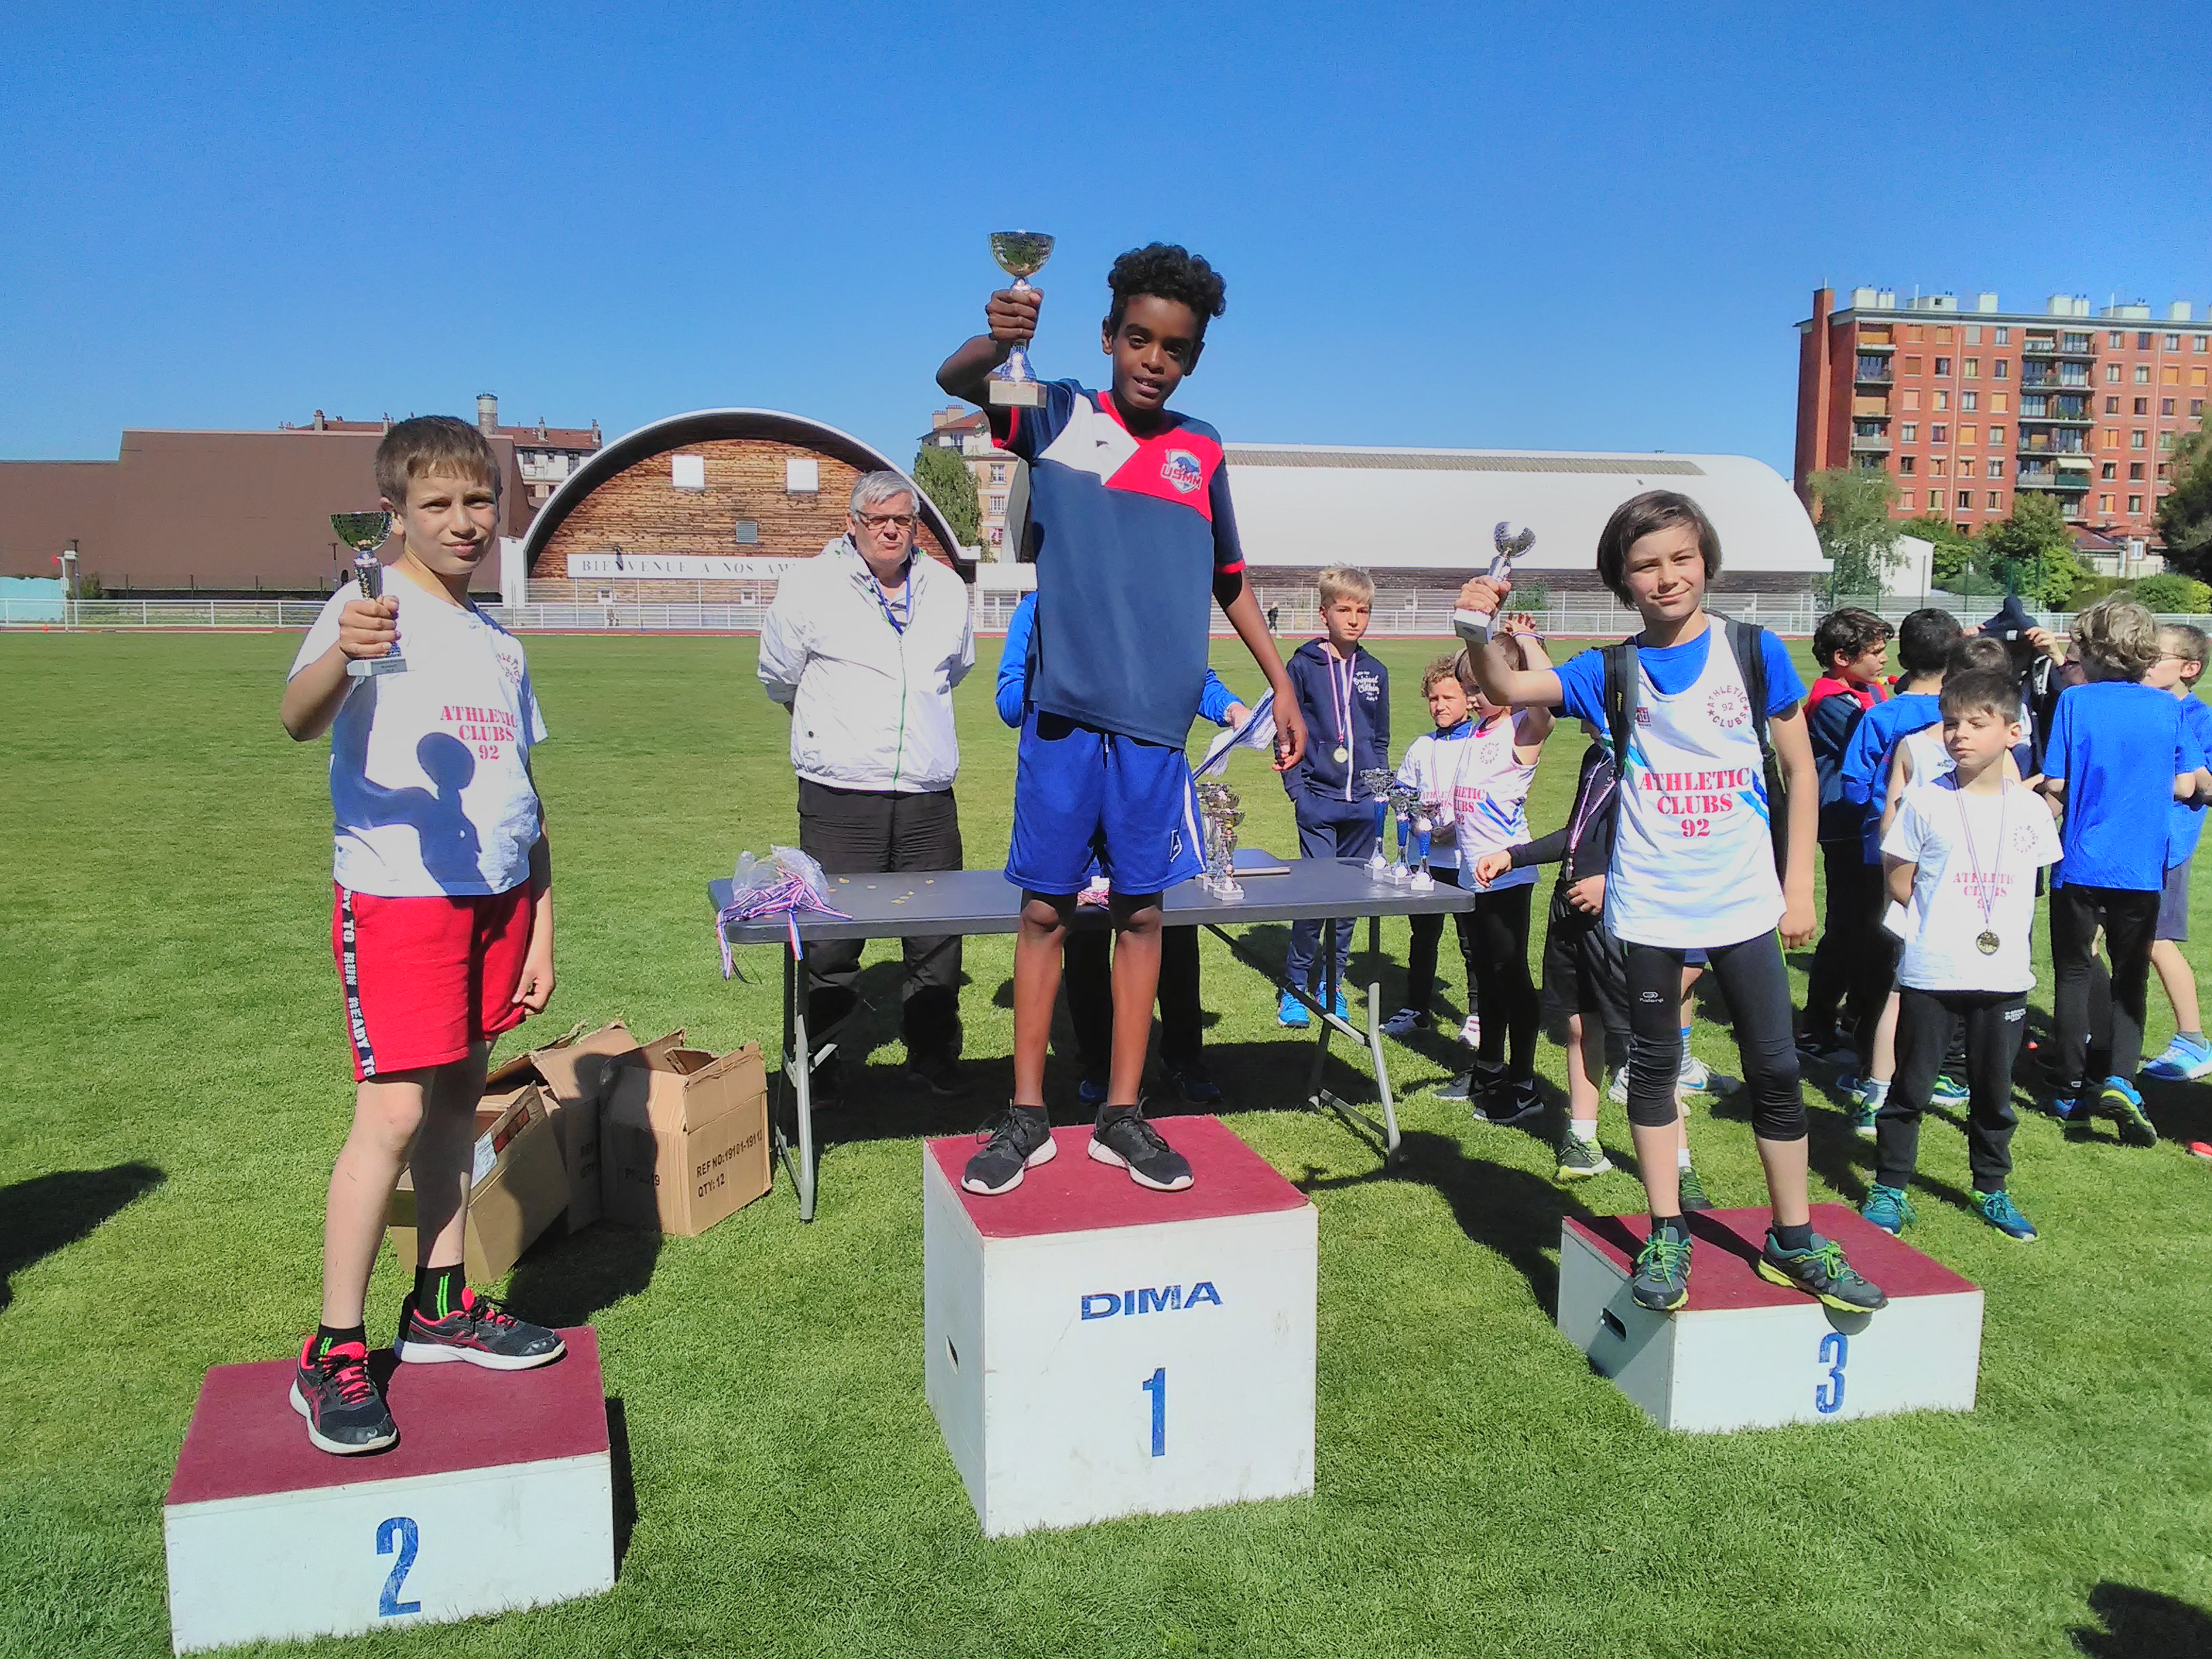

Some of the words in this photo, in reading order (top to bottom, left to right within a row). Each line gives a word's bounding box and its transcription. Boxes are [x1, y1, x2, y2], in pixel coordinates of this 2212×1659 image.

[1161, 464, 1202, 489] USMM
[582, 560, 687, 573] BIENVENUE
[701, 562, 710, 573] A
[722, 562, 754, 573] NOS
[766, 562, 797, 574] AM
[1706, 684, 1747, 708] ATHLETIC
[1721, 702, 1734, 712] 92
[441, 705, 518, 729] ATHLETIC
[1712, 712, 1746, 728] CLUBS
[458, 724, 515, 742] CLUBS
[478, 744, 499, 760] 92
[1638, 767, 1750, 792] ATHLETIC
[1454, 798, 1475, 813] LUBS
[1656, 793, 1734, 815] CLUBS
[1681, 818, 1711, 838] 92
[343, 920, 355, 943] TO
[348, 996, 371, 1049] READY
[696, 1160, 712, 1179] REF
[697, 1179, 716, 1198] QTY:
[716, 1172, 726, 1188] 12
[1080, 1280, 1224, 1321] DIMA
[1816, 1332, 1849, 1414] 3
[1142, 1366, 1166, 1458] 1
[375, 1516, 422, 1618] 2
